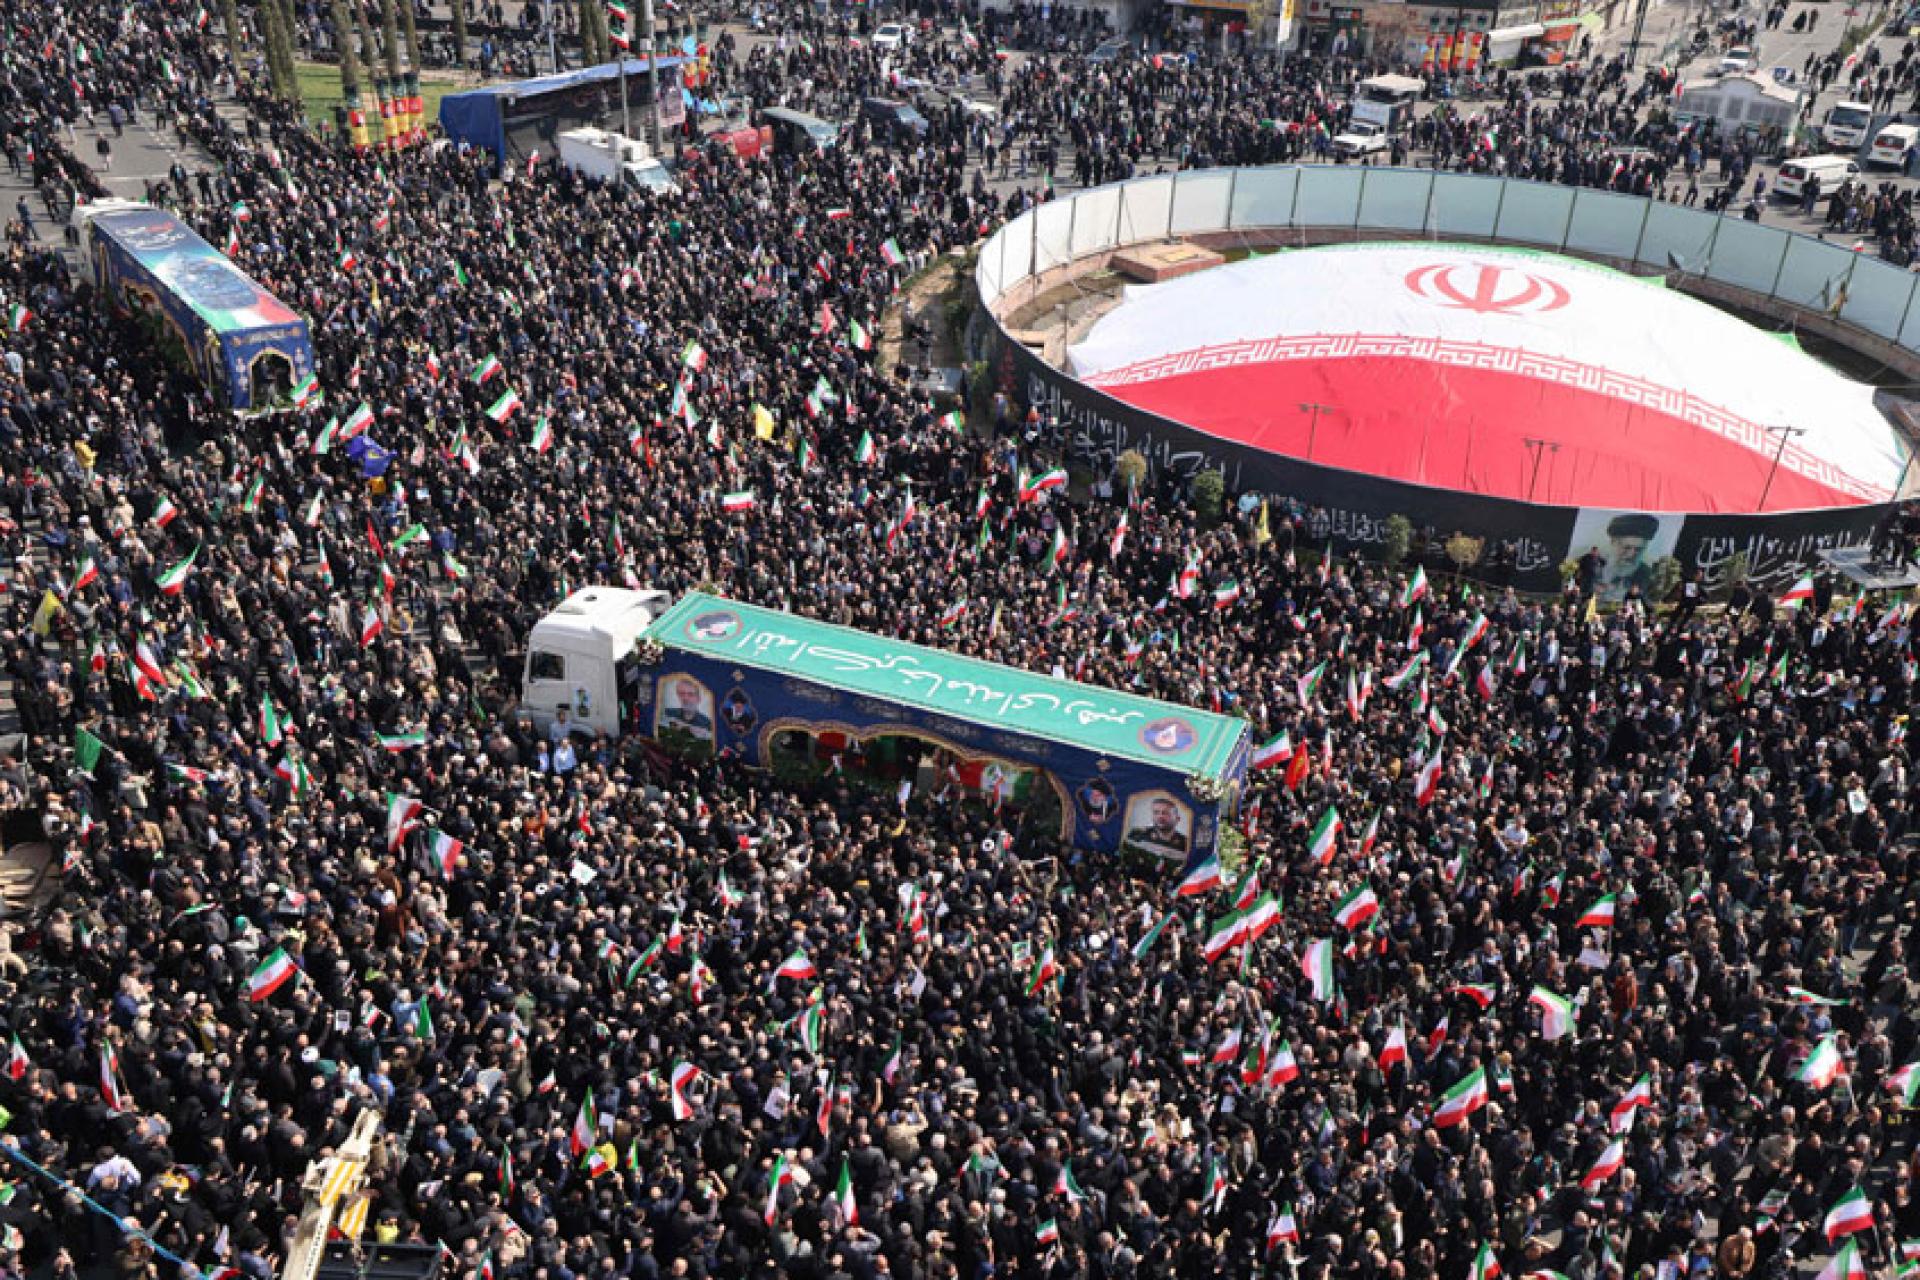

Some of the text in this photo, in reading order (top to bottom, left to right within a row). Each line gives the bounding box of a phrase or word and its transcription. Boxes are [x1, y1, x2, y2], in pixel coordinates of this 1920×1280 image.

[735, 629, 799, 657] الله
[788, 641, 920, 672] اکبر
[1063, 700, 1145, 725] رهبر
